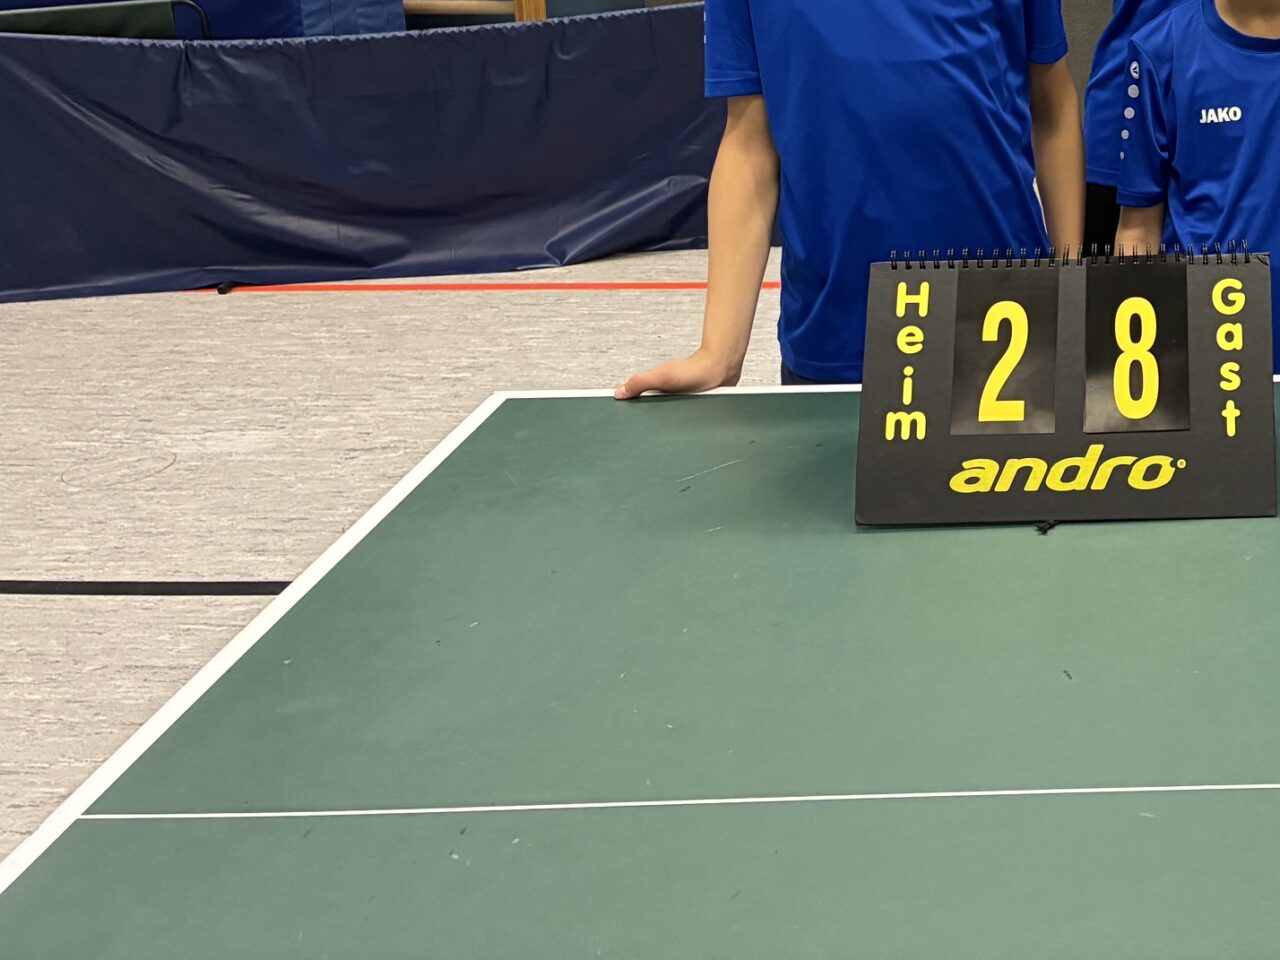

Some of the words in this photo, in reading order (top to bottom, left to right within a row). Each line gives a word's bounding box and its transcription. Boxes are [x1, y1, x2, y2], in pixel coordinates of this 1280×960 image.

[1199, 106, 1242, 124] JAKO
[884, 281, 931, 441] Heim
[977, 300, 1029, 423] 2
[1112, 296, 1160, 420] 8
[1211, 277, 1247, 438] Gast
